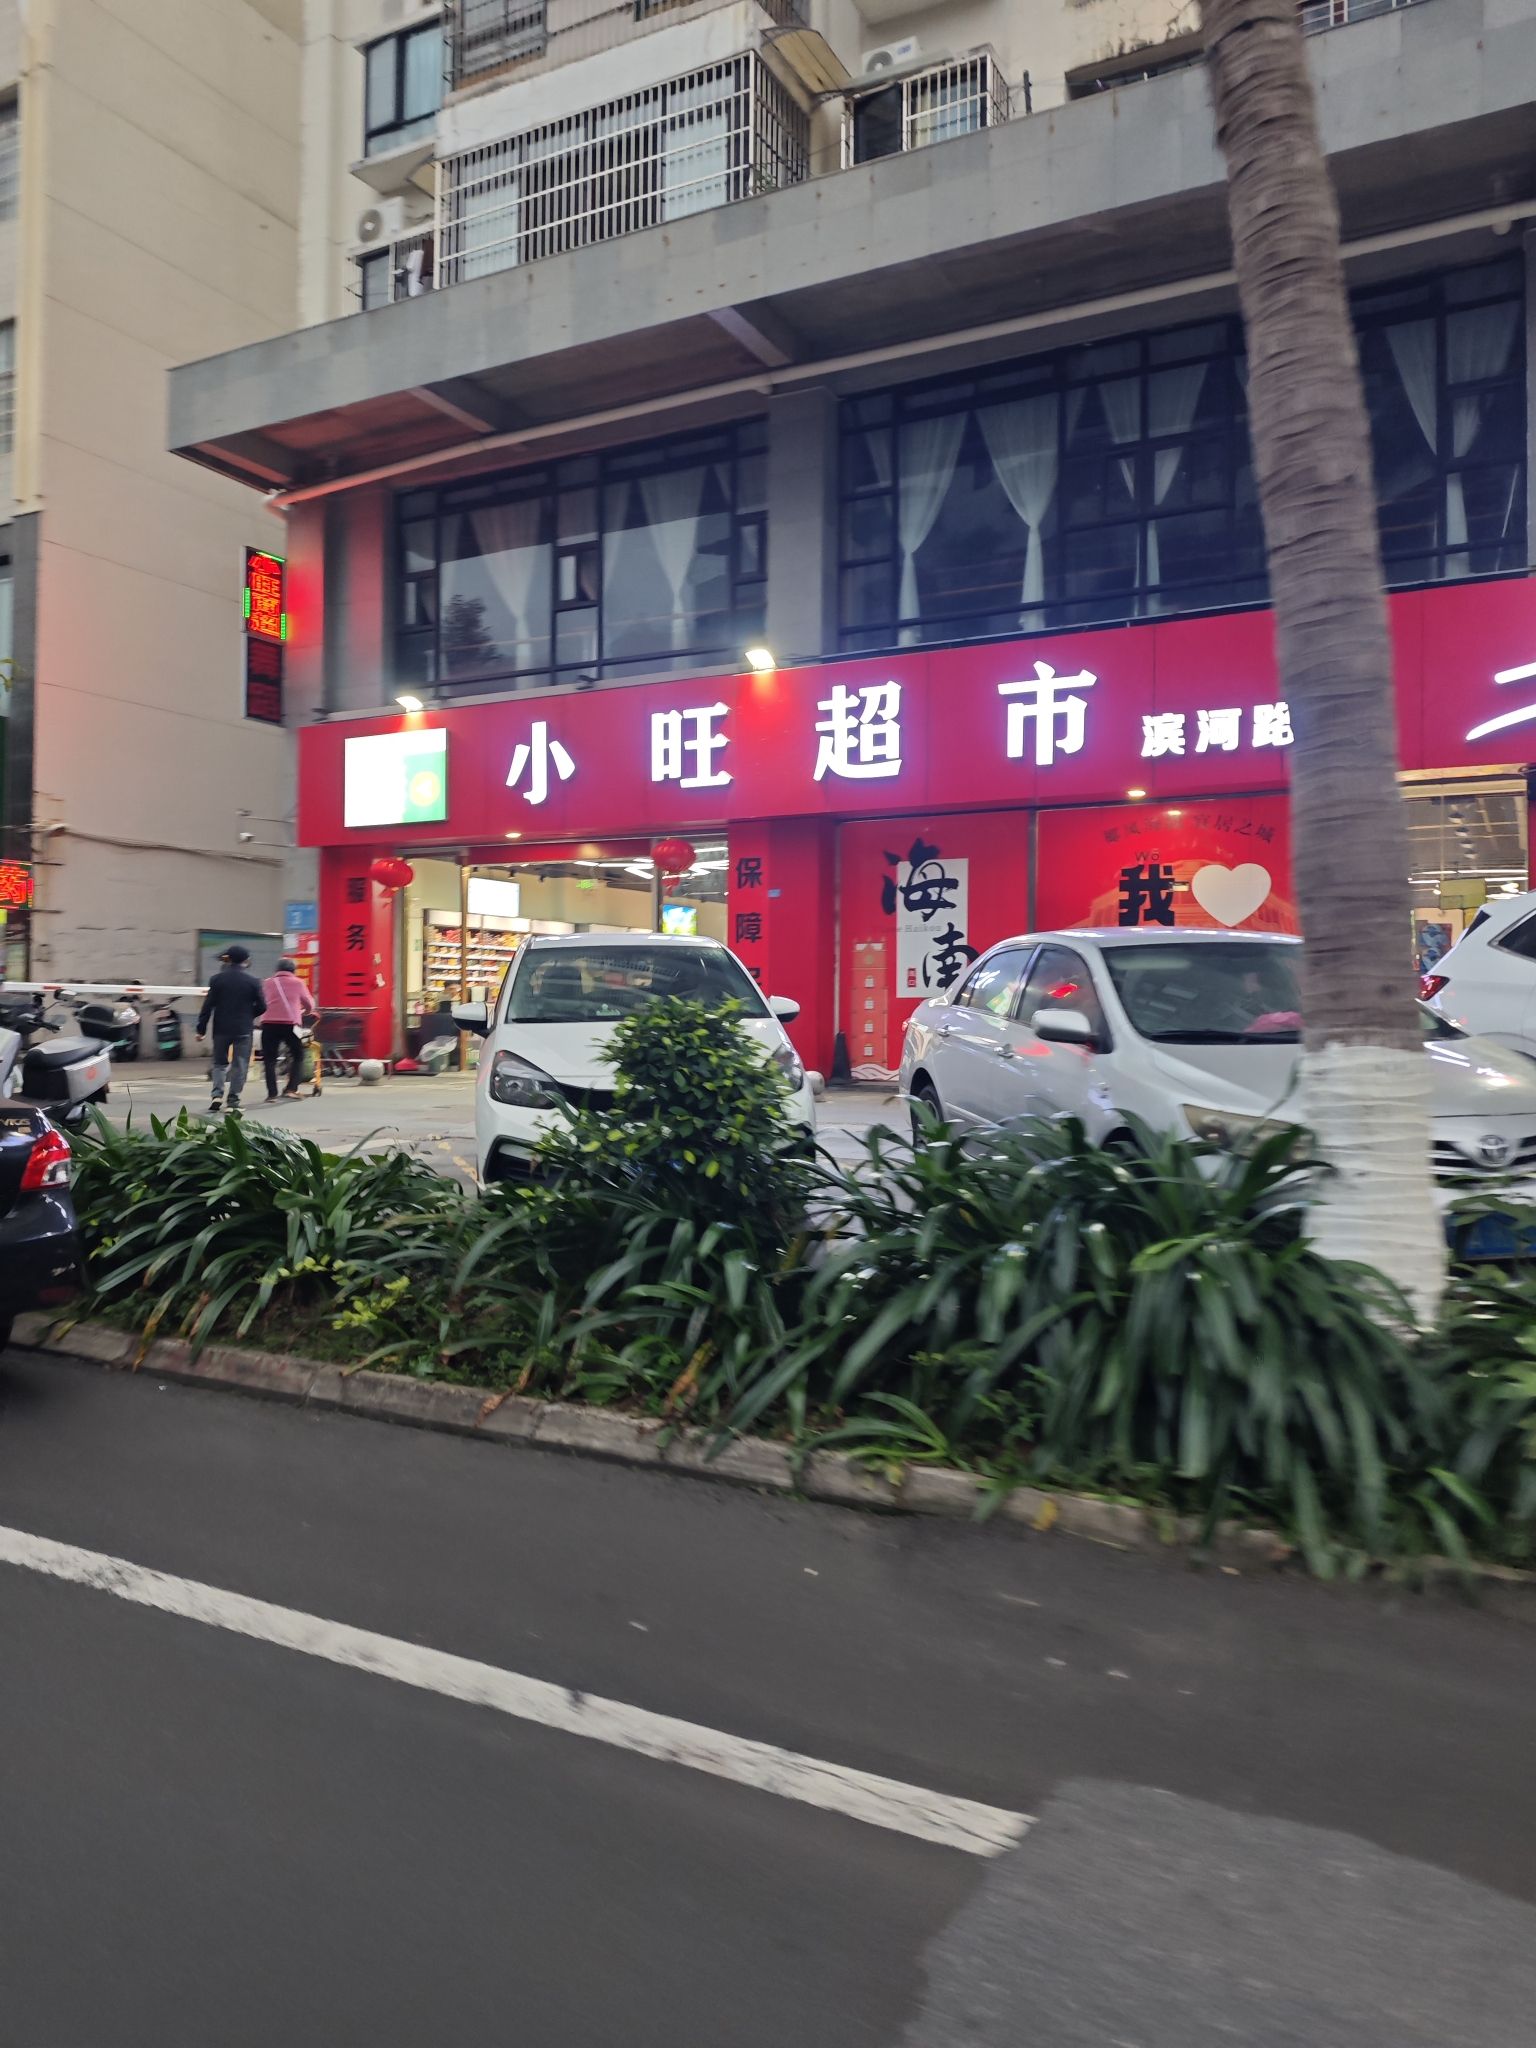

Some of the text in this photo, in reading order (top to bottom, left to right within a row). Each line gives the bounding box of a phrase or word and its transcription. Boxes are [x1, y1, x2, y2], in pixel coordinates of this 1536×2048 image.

[505, 660, 1295, 806] 小旺超市 滨河路
[882, 838, 979, 989] 海南
[1119, 863, 1175, 926] 我
